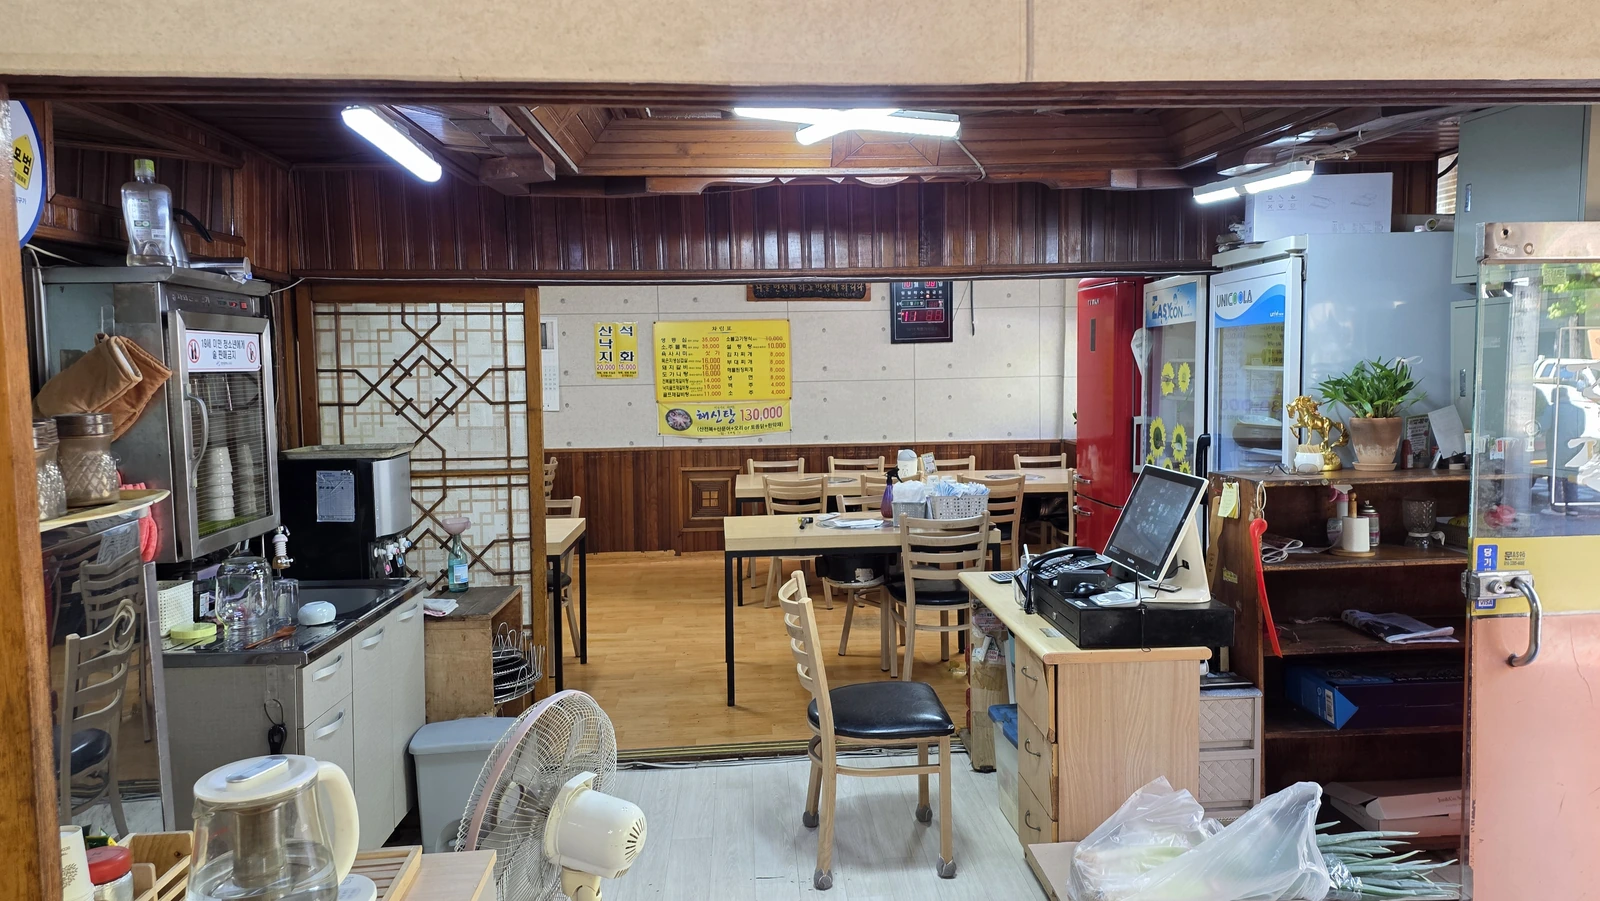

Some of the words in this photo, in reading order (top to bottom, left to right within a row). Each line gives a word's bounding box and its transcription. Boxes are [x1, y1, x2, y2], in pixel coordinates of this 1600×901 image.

[13, 147, 31, 176] 모범
[1216, 290, 1252, 308] UNICOOLA
[201, 339, 211, 348] 19세
[213, 339, 222, 348] 미만
[223, 340, 245, 349] 청소년에게
[598, 325, 613, 362] 산낙지
[619, 325, 635, 362] 석화
[218, 350, 236, 360] 판매금지
[696, 409, 735, 424] 해신탕
[740, 406, 783, 422] 130,000
